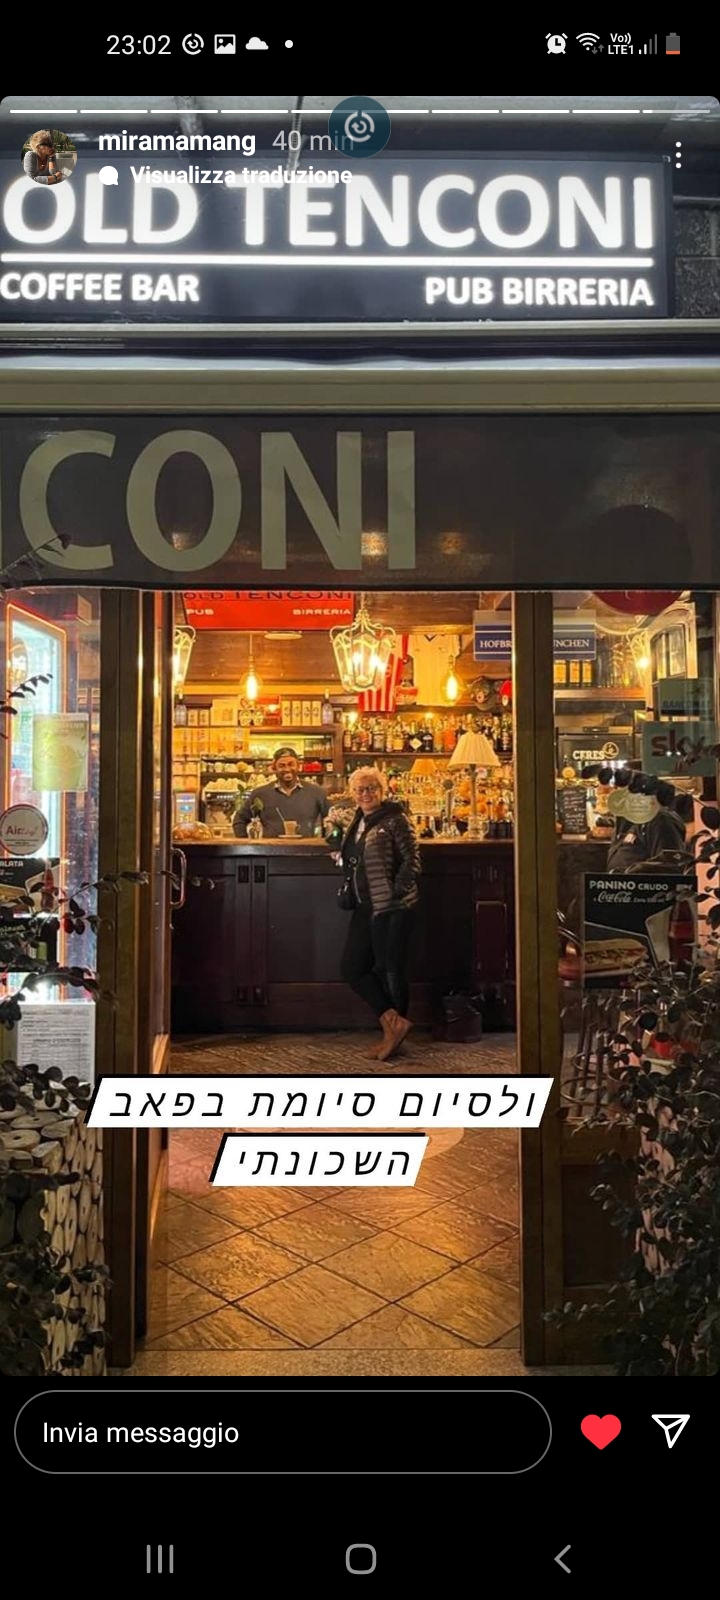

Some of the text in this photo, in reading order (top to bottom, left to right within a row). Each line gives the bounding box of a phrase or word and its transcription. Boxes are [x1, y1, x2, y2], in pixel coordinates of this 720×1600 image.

[2, 173, 653, 248] OLD TENCONI
[0, 272, 654, 306] COFFEE BAR PUB BIRRERIA
[0, 429, 416, 571] CONI
[186, 608, 351, 616] PUB BIRRERIA
[588, 880, 636, 890] PANINO
[637, 883, 669, 891] CRUDO
